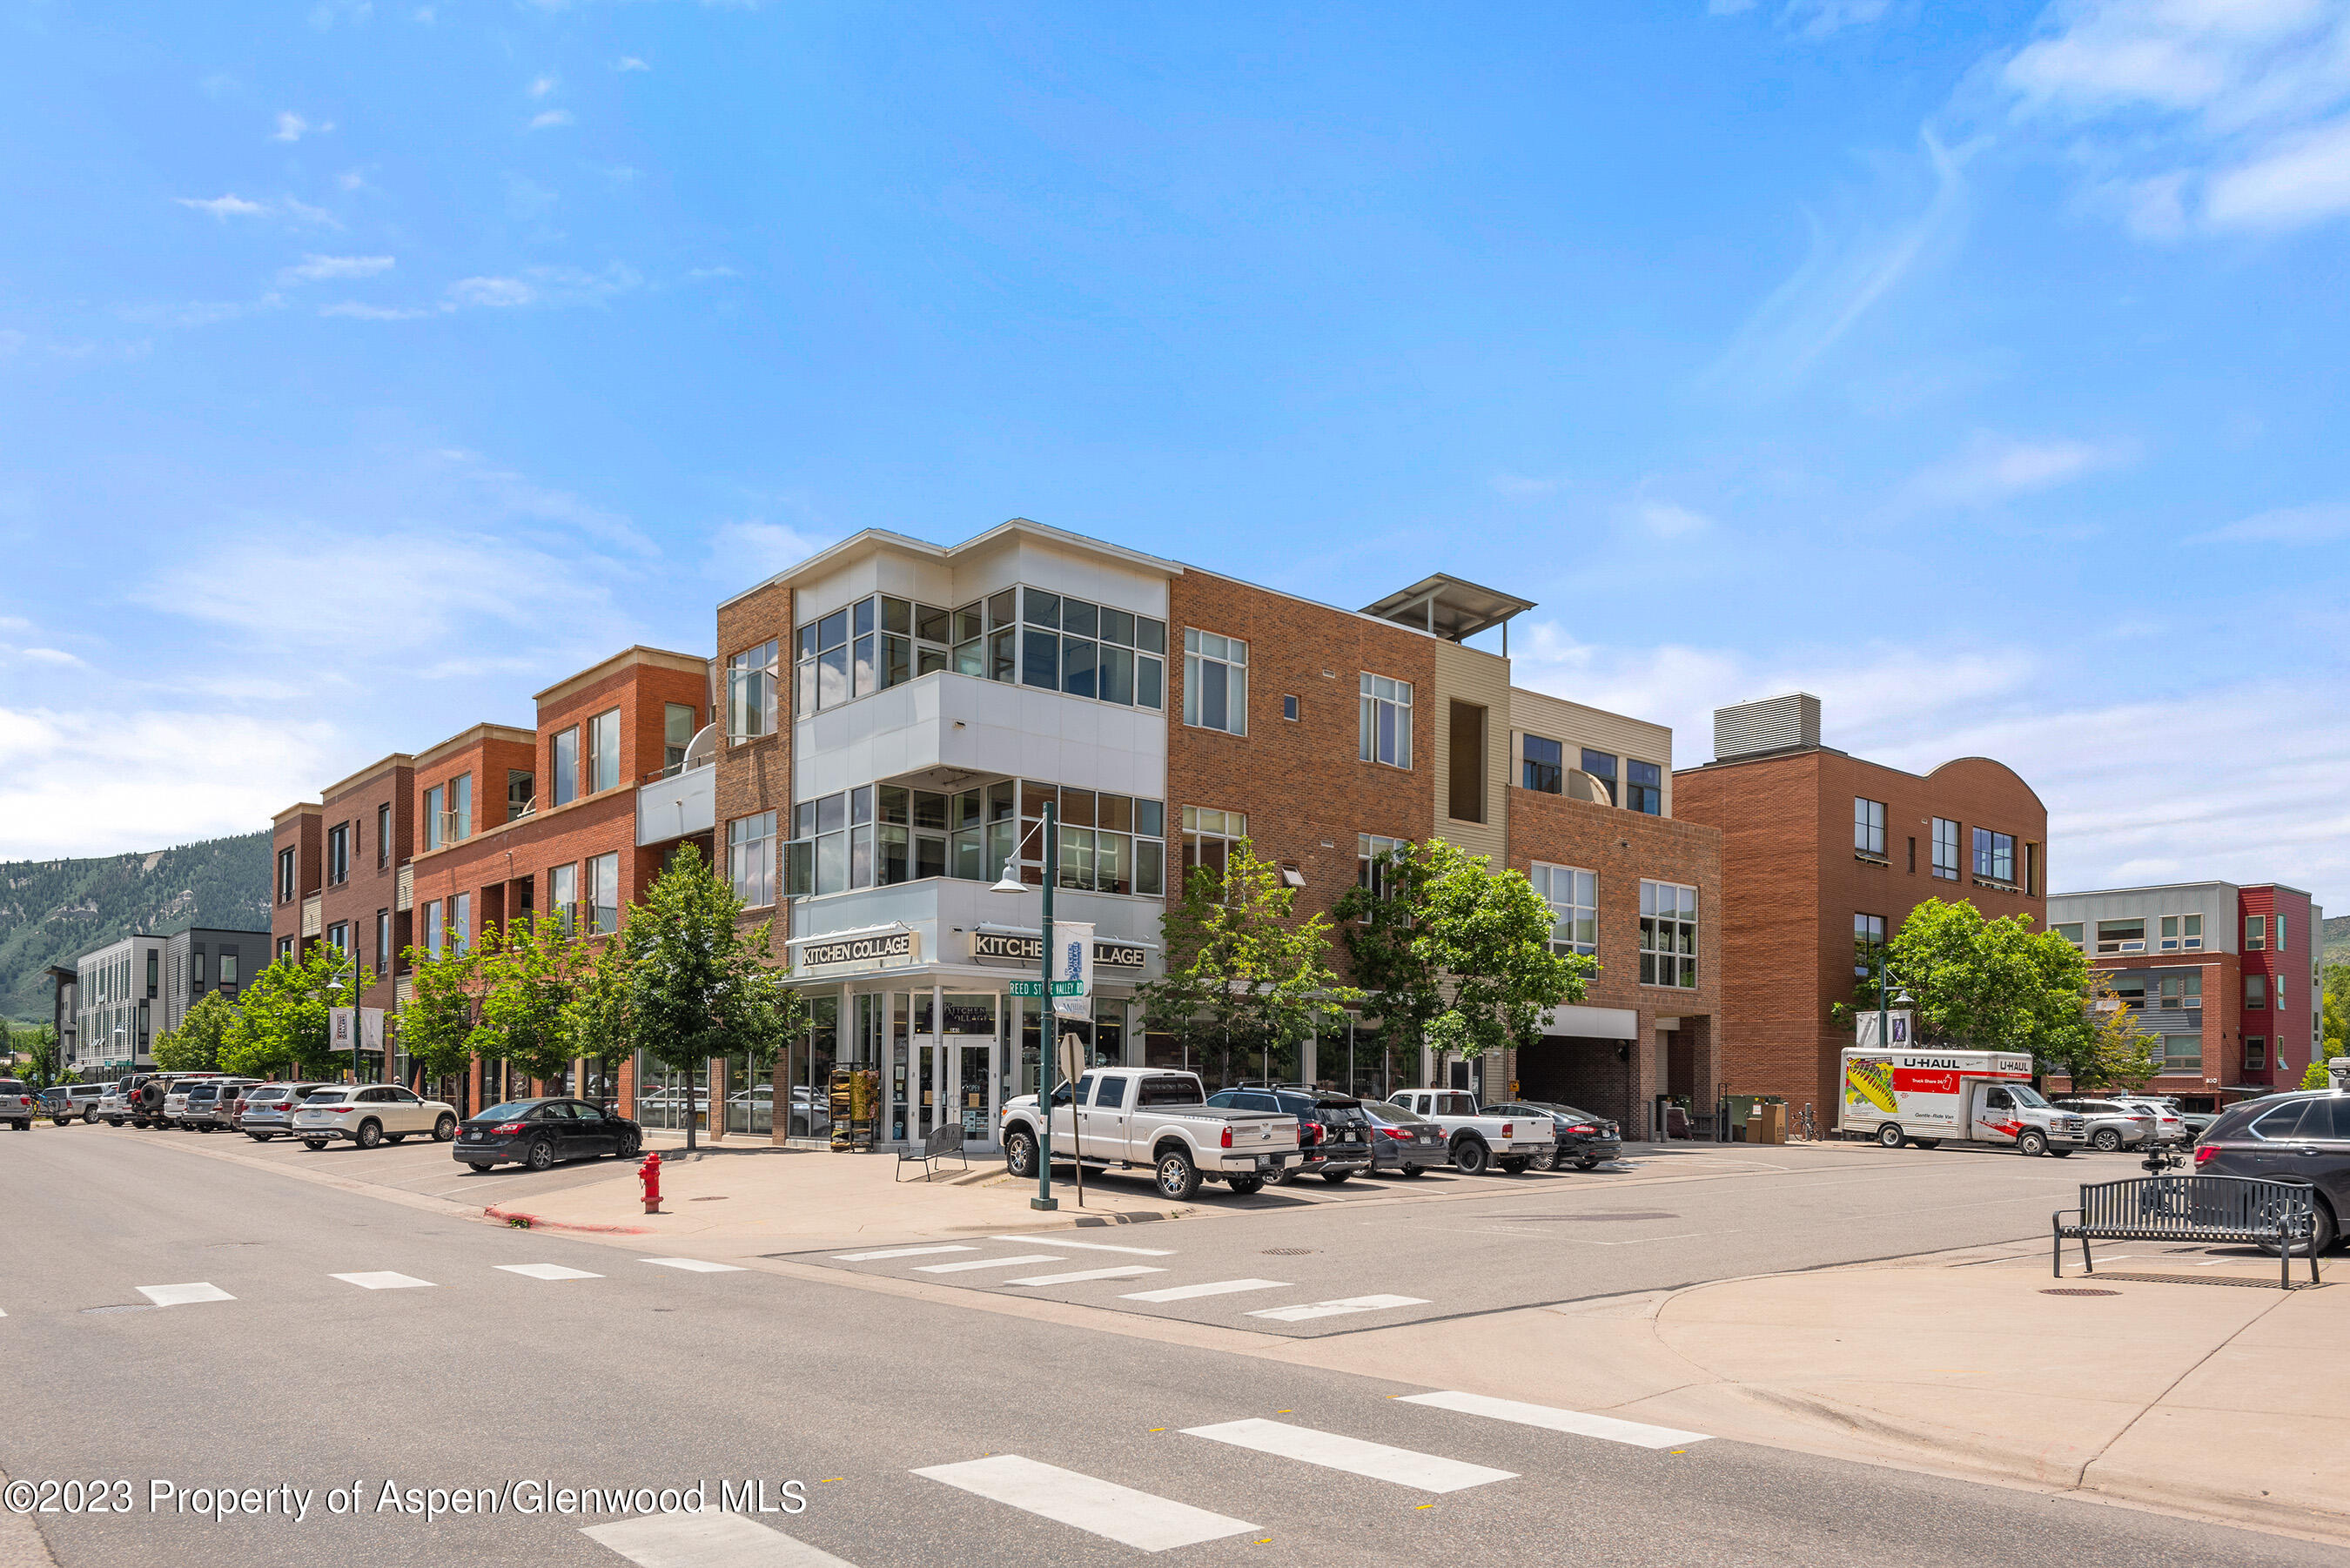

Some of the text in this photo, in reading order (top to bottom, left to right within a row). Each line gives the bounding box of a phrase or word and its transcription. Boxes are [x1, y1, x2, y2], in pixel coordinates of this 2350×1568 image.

[803, 935, 910, 964] KITCHEN COLLAGE
[977, 936, 1043, 956] KITCHE
[1064, 944, 1073, 975] KITCHEN
[1010, 982, 1029, 995] REED
[1056, 982, 1074, 995] VALLEY
[1076, 982, 1084, 994] RD
[943, 1002, 986, 1016] KITCHEN
[950, 1014, 989, 1022] OLLAGE
[1904, 1058, 1960, 1069] U-HAUL
[2000, 1061, 2028, 1071] U-HAUL
